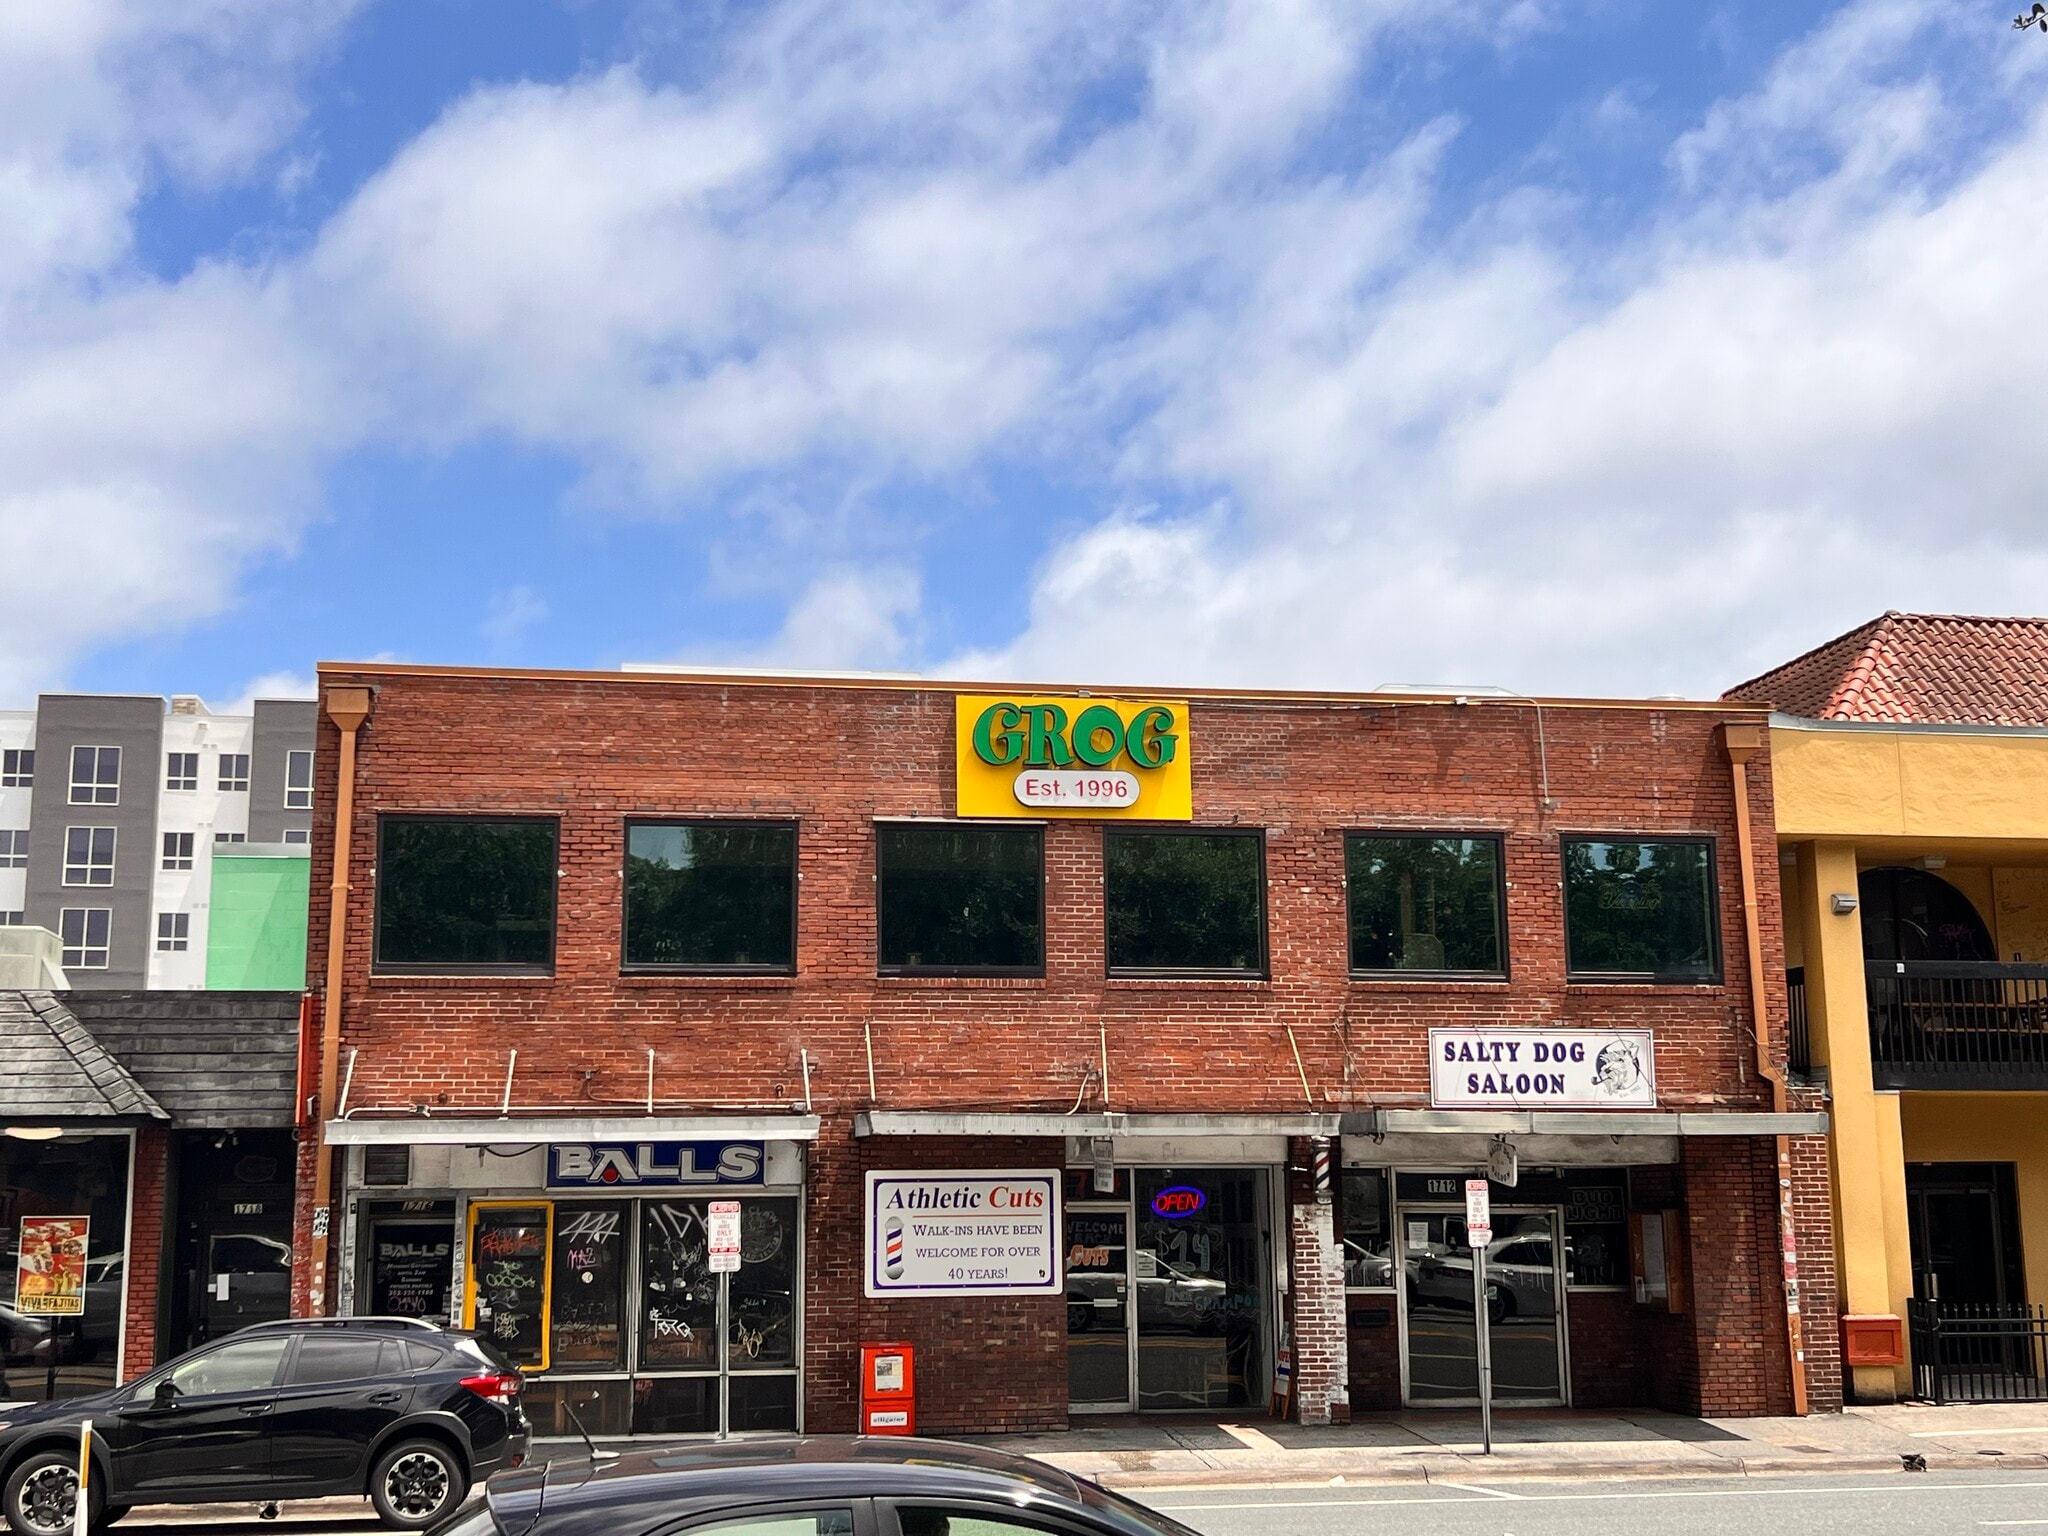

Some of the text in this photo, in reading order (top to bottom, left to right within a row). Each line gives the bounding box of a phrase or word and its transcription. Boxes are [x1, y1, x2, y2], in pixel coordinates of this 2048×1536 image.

[973, 703, 1179, 769] GROG
[1026, 779, 1128, 798] Est. 1996
[1444, 1041, 1585, 1063] SALTY DOG
[1467, 1073, 1566, 1095] SALOON
[552, 1143, 762, 1183] BALLS
[1428, 1180, 1456, 1193] 1712
[885, 1186, 1044, 1210] Athletic Cuts
[1156, 1193, 1199, 1211] OPEN
[1571, 1189, 1614, 1205] BUD
[1566, 1205, 1623, 1221] LIGHT
[912, 1224, 1043, 1237] WALK-INS HAVE BEEN
[380, 1243, 450, 1257] BALLS
[915, 1246, 1041, 1258] WELCOME FOR OVER
[948, 1267, 1008, 1280] 40 YEARS!
[49, 1298, 80, 1308] FAJITAS
